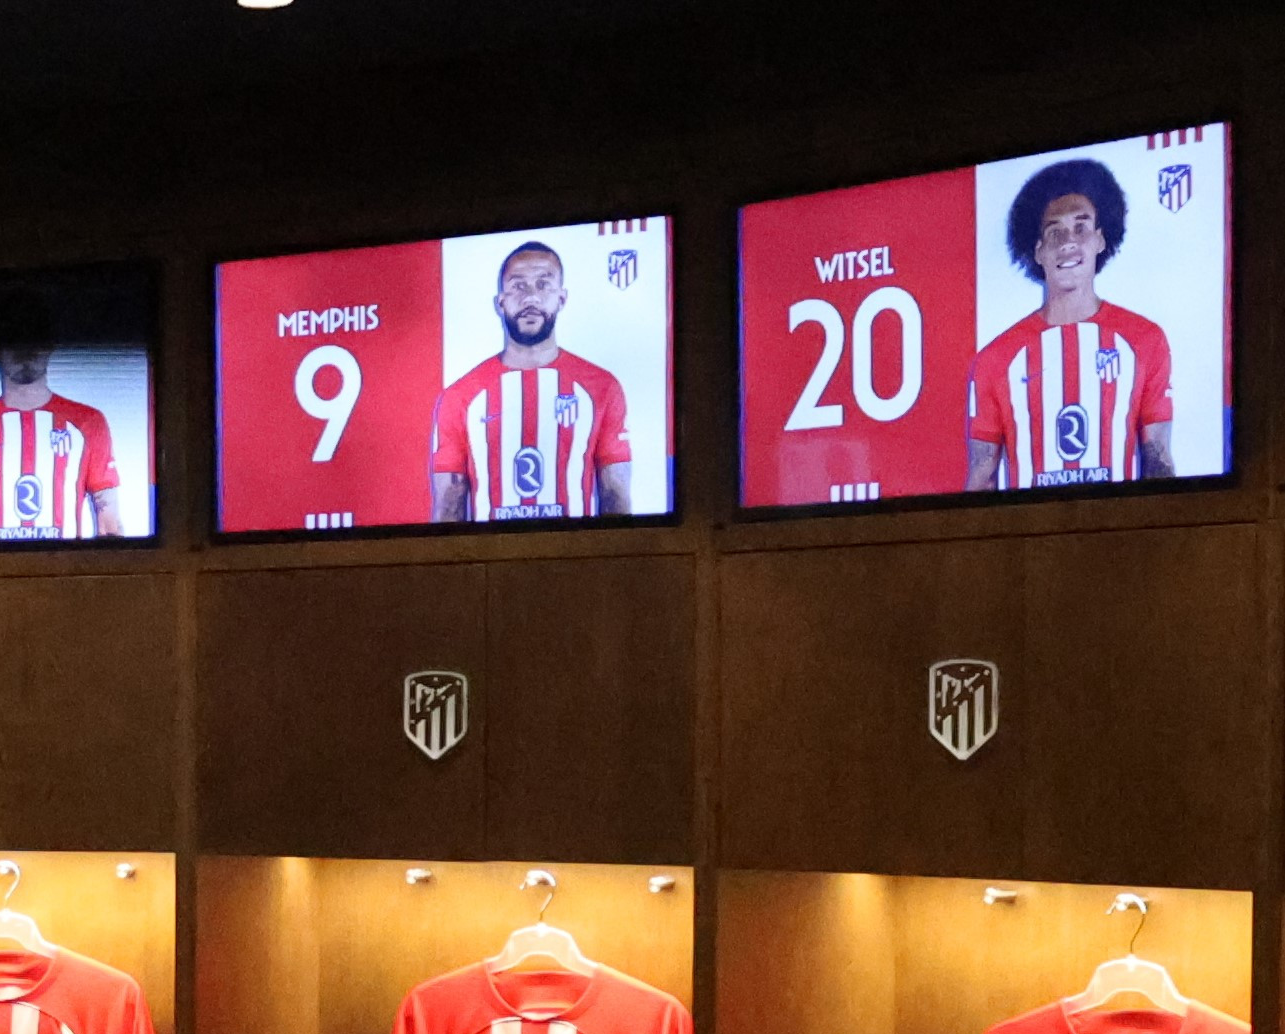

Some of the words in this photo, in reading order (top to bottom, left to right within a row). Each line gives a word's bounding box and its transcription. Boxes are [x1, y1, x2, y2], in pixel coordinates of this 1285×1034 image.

[814, 245, 895, 284] WITSEL
[278, 304, 380, 338] MEMPHIS
[783, 286, 923, 431] 20
[294, 345, 362, 463] 9
